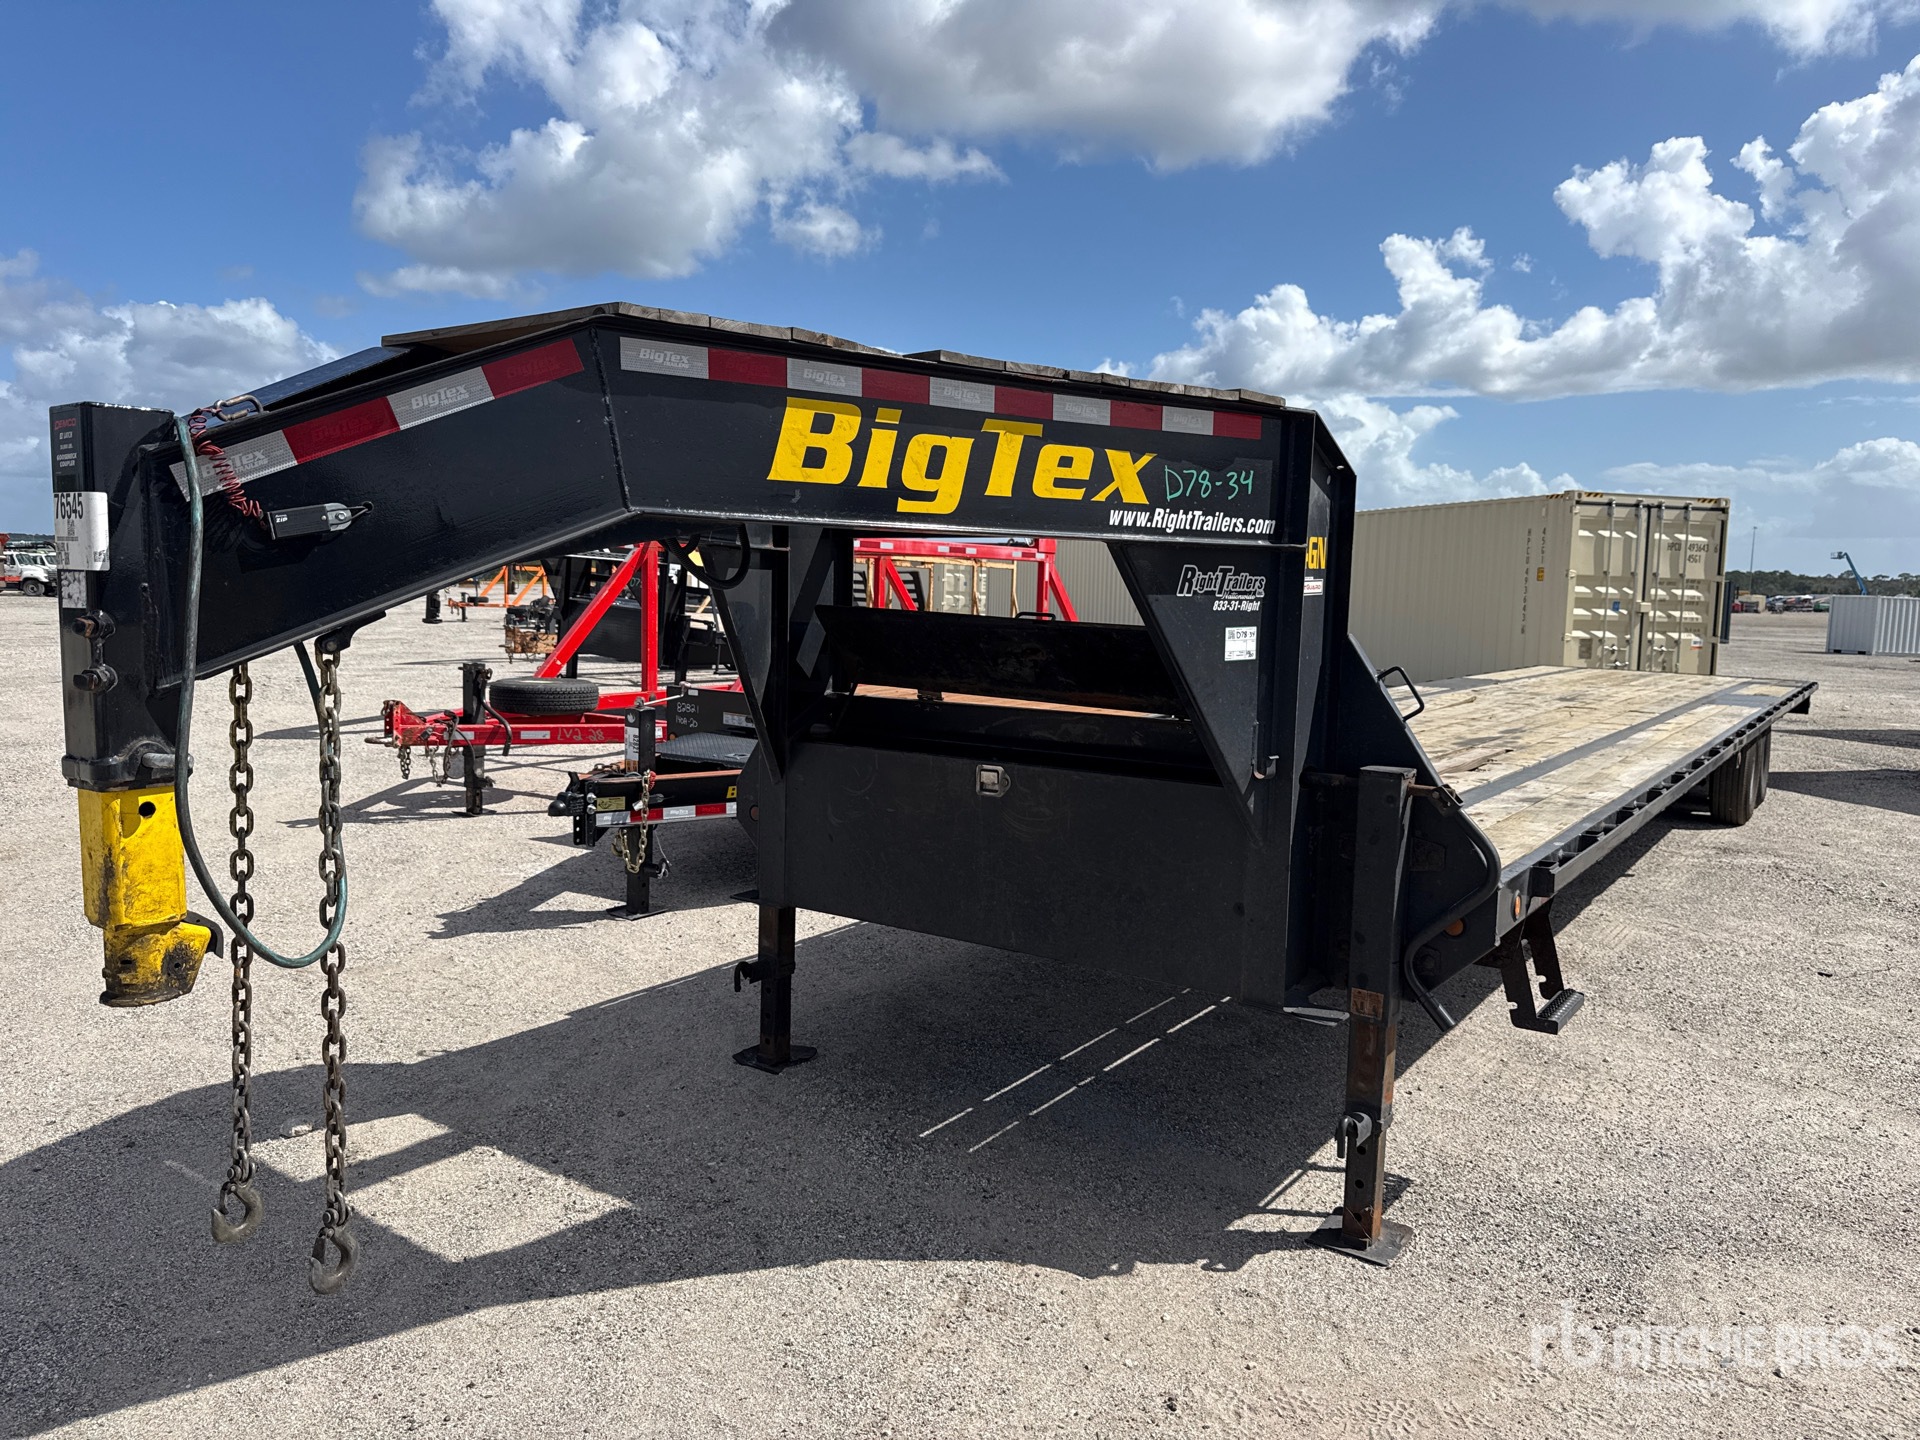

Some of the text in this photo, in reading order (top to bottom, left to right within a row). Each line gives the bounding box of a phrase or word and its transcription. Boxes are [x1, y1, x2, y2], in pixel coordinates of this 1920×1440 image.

[639, 348, 690, 364] BigTex
[803, 368, 846, 383] BigTex
[411, 384, 467, 410] BigTex
[440, 392, 470, 406] TRAILERS
[943, 386, 981, 400] BigTex
[767, 396, 1158, 515] BigTex
[1164, 465, 1255, 503] D78-34
[53, 492, 84, 520] 76545
[1108, 507, 1276, 535] www.RightTrailers.com
[1306, 536, 1328, 570] -GN
[1687, 543, 1710, 553] 493643
[1686, 554, 1702, 564] 45G1
[1304, 583, 1322, 591] GUARD
[1212, 600, 1261, 612] 833-31-Right
[676, 701, 700, 714] 82821
